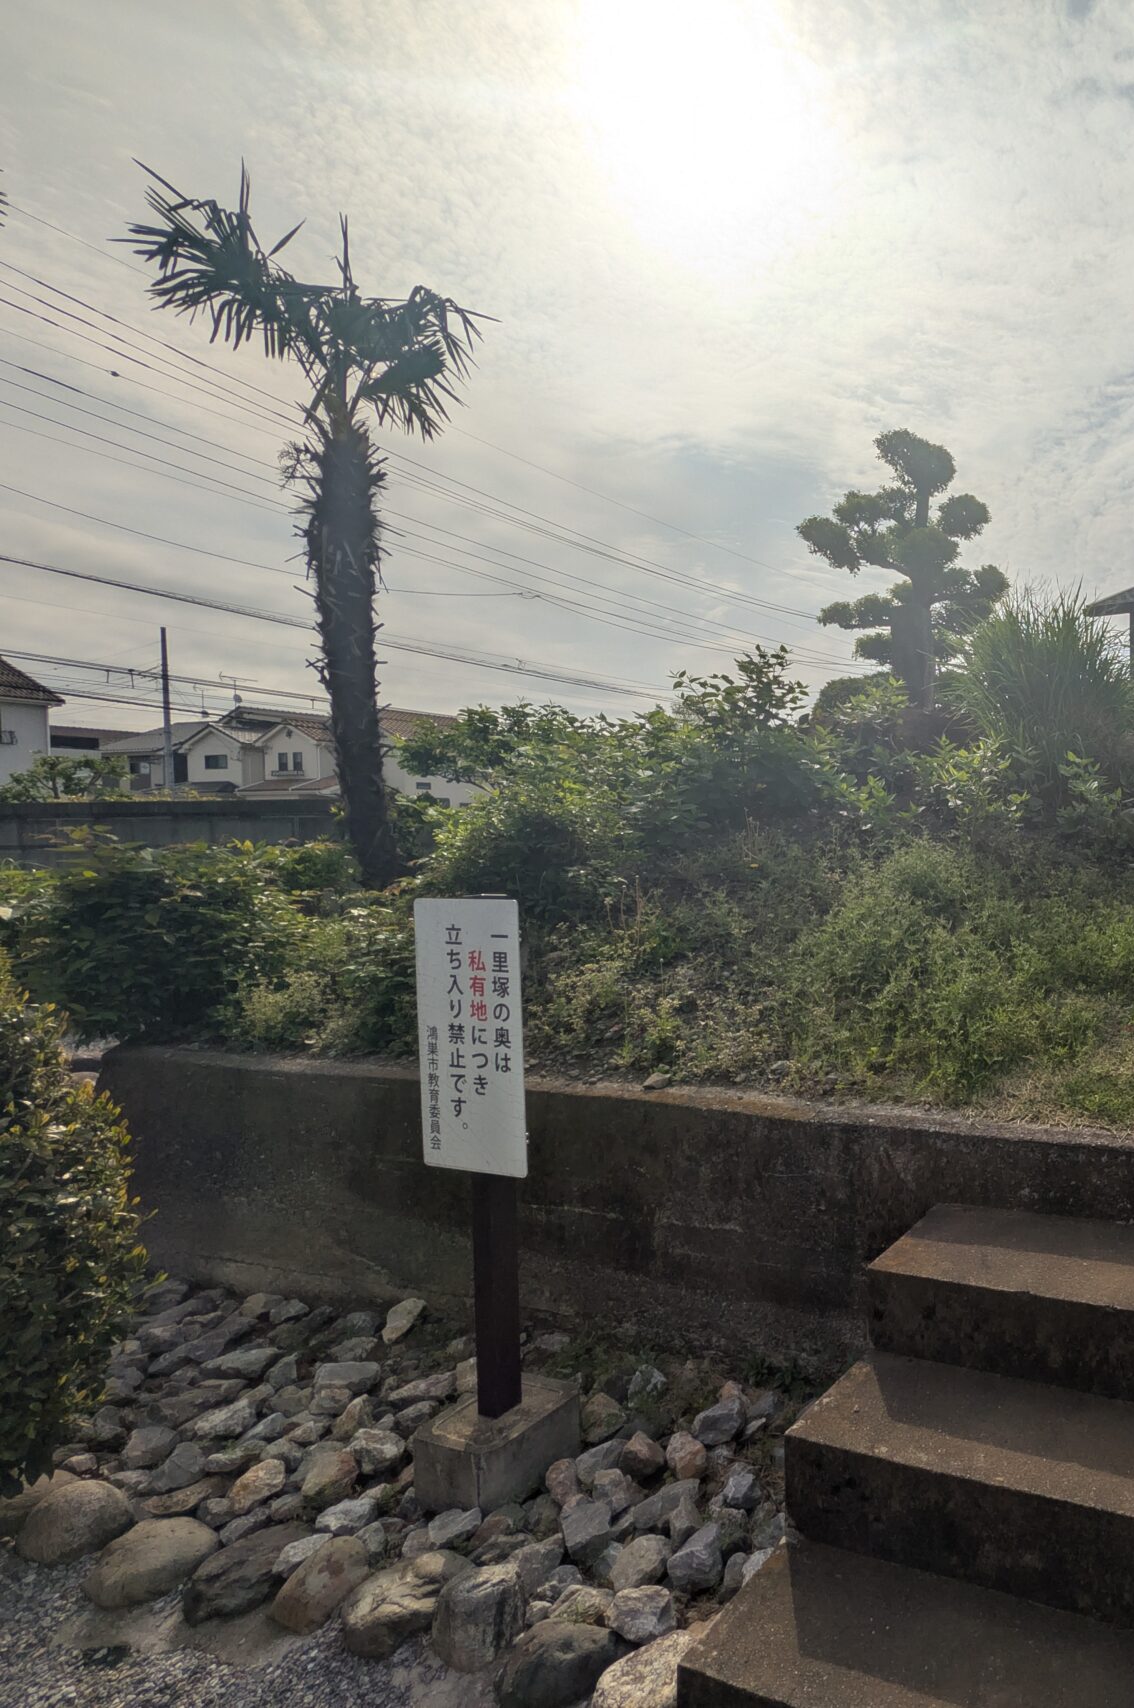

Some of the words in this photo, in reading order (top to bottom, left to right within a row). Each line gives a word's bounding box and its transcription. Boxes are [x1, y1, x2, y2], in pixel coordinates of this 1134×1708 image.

[445, 923, 468, 1130] 立ち入り禁止です。
[467, 949, 489, 1096] 私有地につき
[490, 932, 512, 1073] 一里塚の奥は
[425, 1025, 441, 1150] 鴻巣市教育委員会
